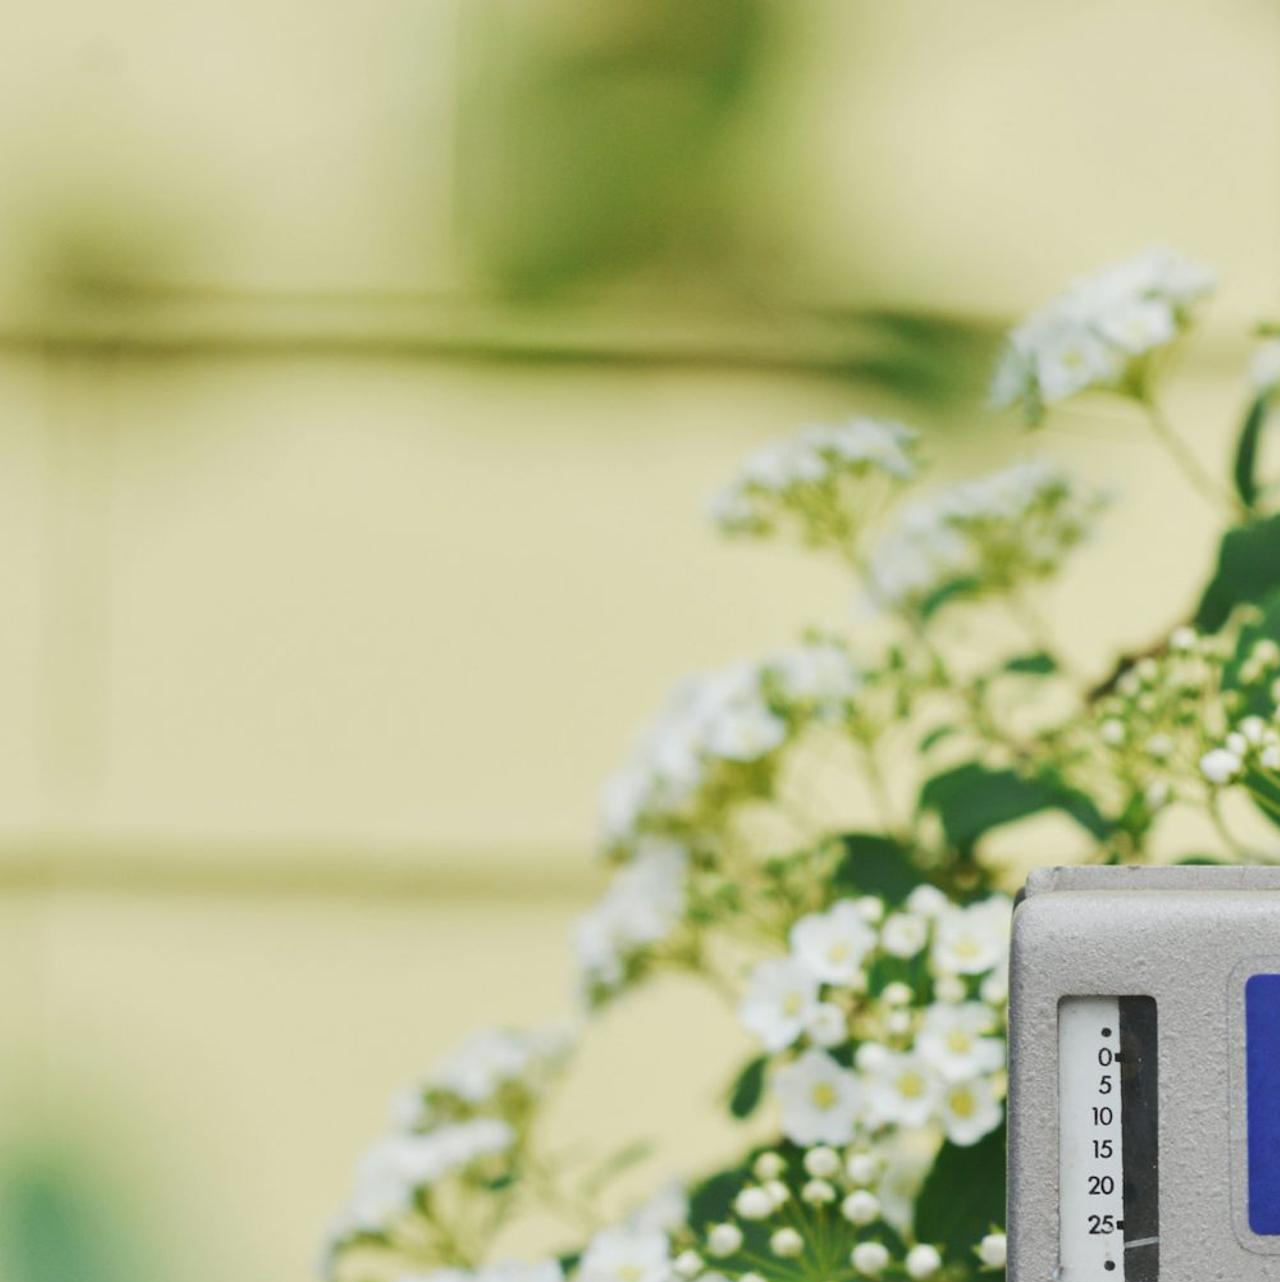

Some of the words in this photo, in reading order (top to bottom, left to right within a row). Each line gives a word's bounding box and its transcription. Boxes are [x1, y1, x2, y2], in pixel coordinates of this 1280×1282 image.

[1098, 1047, 1112, 1066] 0
[1098, 1075, 1112, 1094] 5
[1092, 1107, 1113, 1125] 10
[1093, 1140, 1113, 1158] 15
[1088, 1176, 1114, 1195] 20
[1088, 1215, 1114, 1235] 25
